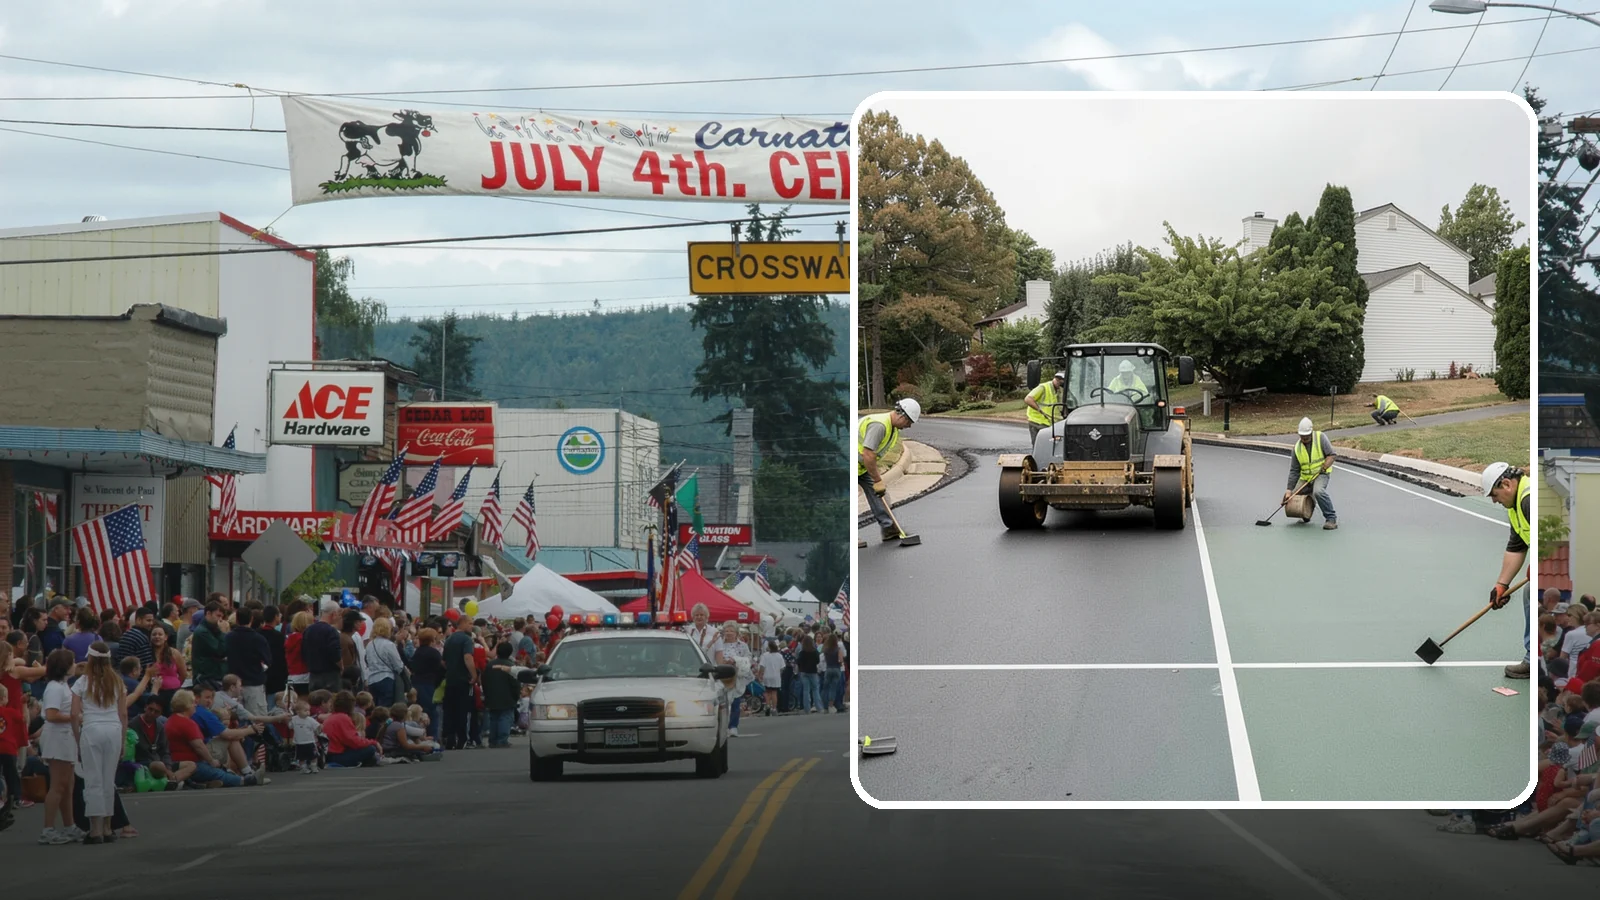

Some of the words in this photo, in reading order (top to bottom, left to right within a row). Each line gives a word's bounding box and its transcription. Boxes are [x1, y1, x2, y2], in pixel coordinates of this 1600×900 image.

[481, 140, 605, 192] JULY
[632, 151, 746, 197] 4th.
[697, 254, 850, 280] CROSSWA
[283, 380, 373, 420] ACE
[405, 409, 453, 422] CEDAR
[283, 421, 371, 436] Hardware
[416, 428, 477, 447] Coca-Cola
[95, 485, 124, 495] Vincent
[126, 486, 136, 495] de
[137, 486, 155, 496] Paul
[212, 516, 331, 535] HARDARE
[688, 526, 741, 535] CRNATION
[699, 535, 730, 543] GLASS
